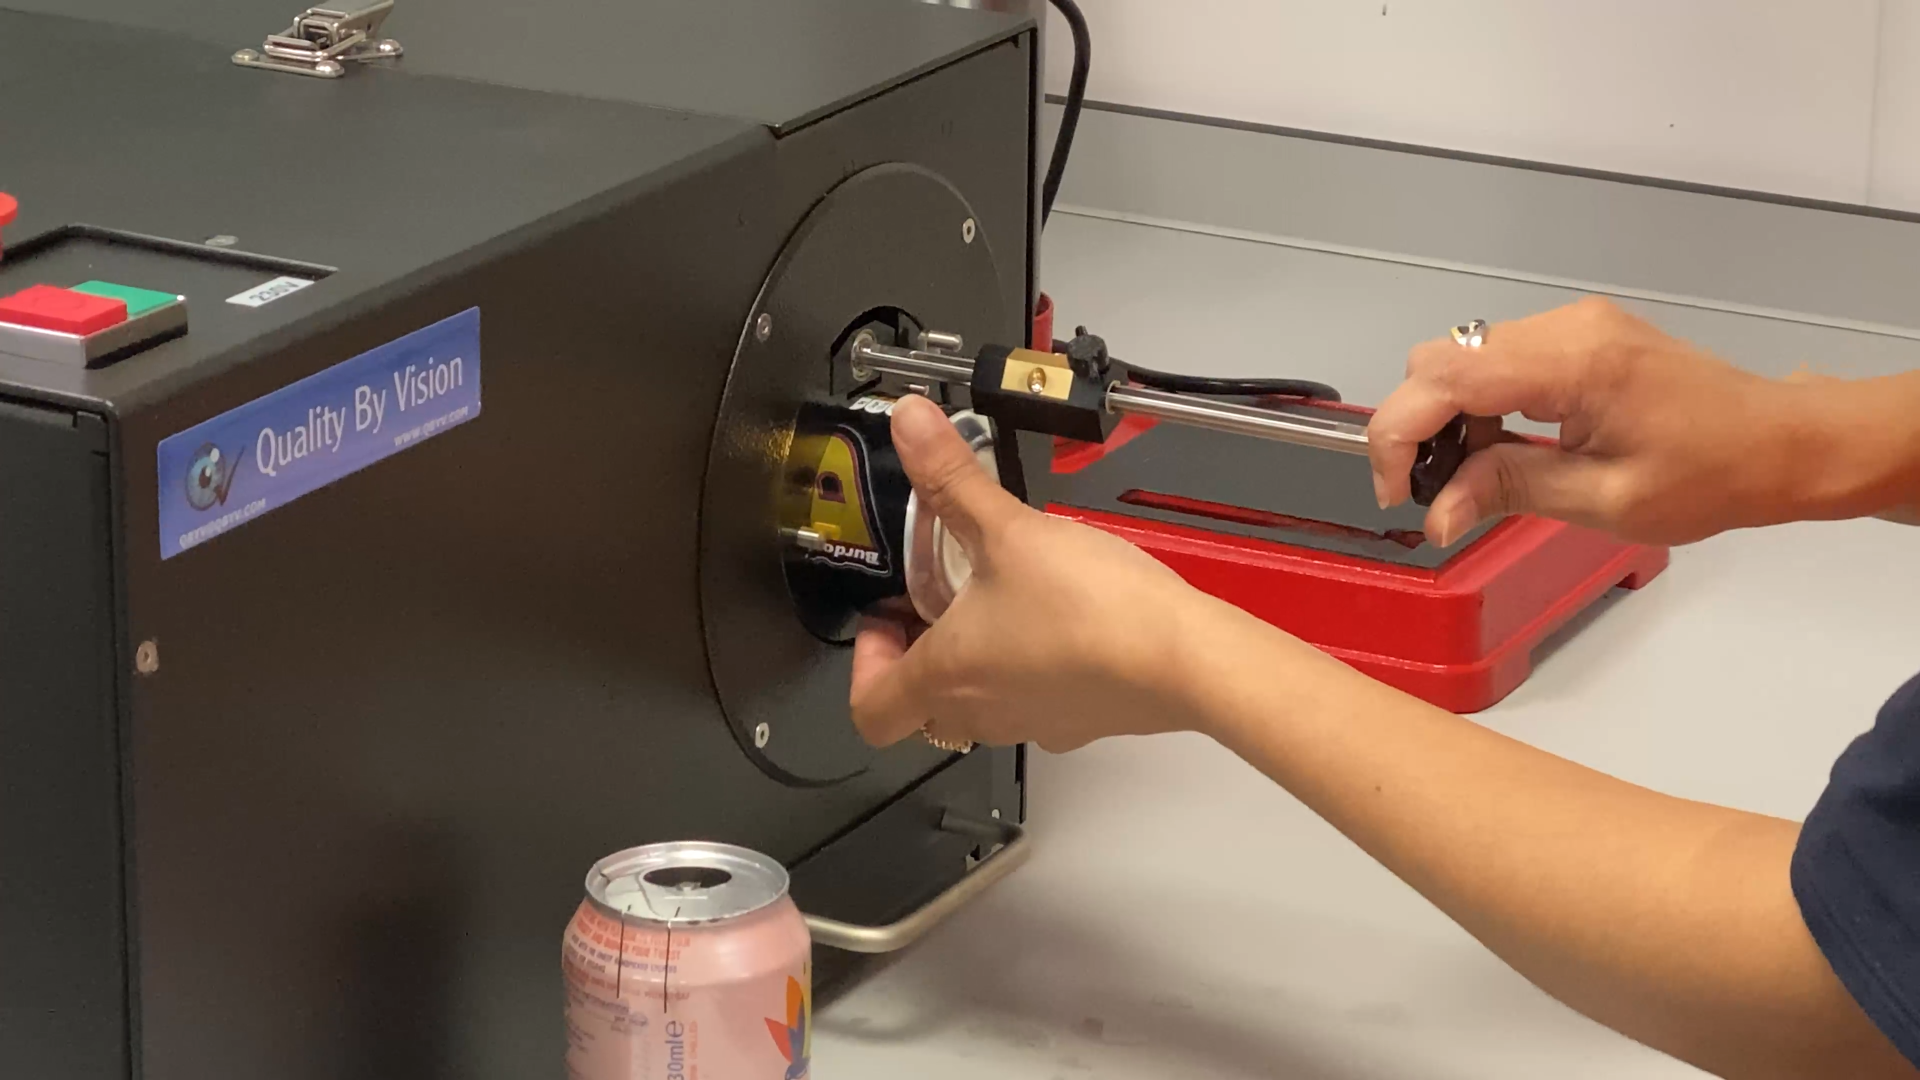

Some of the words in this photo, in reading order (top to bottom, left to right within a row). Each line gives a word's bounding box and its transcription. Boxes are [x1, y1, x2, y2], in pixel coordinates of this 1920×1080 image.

[256, 405, 346, 477] Quality
[355, 385, 386, 433] By
[394, 356, 463, 411] Vision
[823, 543, 880, 566] Burdo
